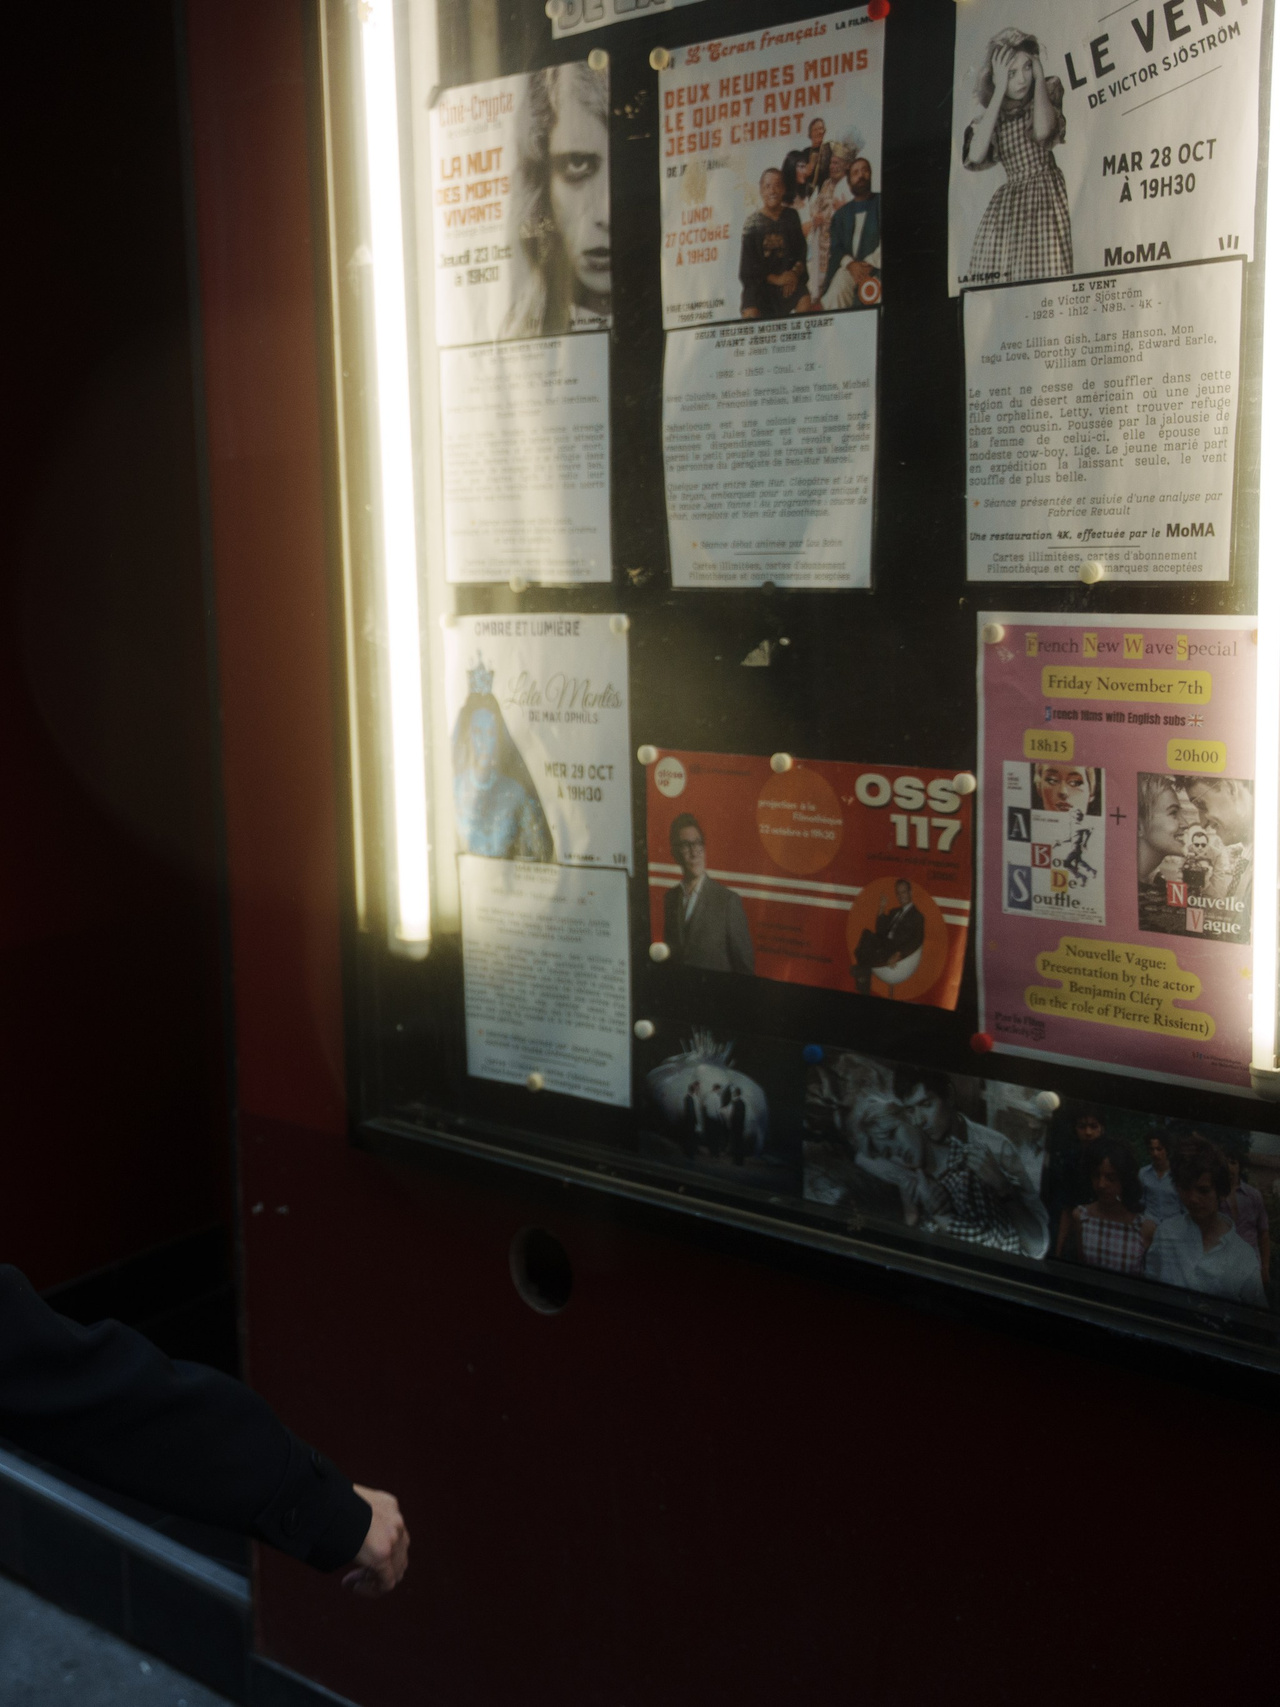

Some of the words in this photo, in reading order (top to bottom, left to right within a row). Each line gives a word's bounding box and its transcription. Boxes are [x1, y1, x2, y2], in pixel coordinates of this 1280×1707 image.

[760, 20, 827, 50] français
[1064, 34, 1115, 89] LE
[1131, 0, 1248, 53] VEN
[1087, 90, 1107, 109] DE
[1108, 63, 1159, 98] VICTOR
[1162, 21, 1241, 71] SJÖSTRÖM
[664, 83, 710, 110] DEUX
[719, 64, 794, 98] HEURES
[804, 49, 868, 82] MOINS
[664, 111, 684, 134] LE
[693, 97, 754, 128] QUART
[764, 81, 835, 115] AVANT
[730, 113, 805, 145] CHRIST
[440, 155, 462, 180] LA
[467, 146, 504, 175] NUIT
[1103, 151, 1143, 176] MAR
[1150, 146, 1171, 169] 28
[1178, 138, 1216, 164] OCT
[465, 175, 511, 200] MORTS
[1119, 175, 1132, 203] À
[1140, 172, 1196, 199] 19H30
[443, 201, 503, 229] VIVANTS
[681, 205, 714, 226] LUNDI
[1104, 241, 1172, 267] MoMA
[957, 275, 969, 284] LA
[1071, 282, 1086, 292] LE
[1089, 279, 1116, 290] VENT
[1040, 297, 1052, 308] de
[1058, 293, 1090, 306] Victor
[1095, 287, 1142, 303] Sjöström
[1033, 309, 1054, 319] 1928
[1026, 336, 1059, 348] Lillian
[1095, 331, 1116, 342] Lars
[1171, 324, 1194, 335] Mon
[1034, 346, 1076, 360] Dorothy
[1138, 337, 1180, 350] Edward
[1044, 357, 1086, 369] William
[1091, 353, 1142, 366] Orlamond
[989, 387, 1011, 396] vent
[1020, 386, 1032, 394] ne
[1041, 383, 1072, 393] cesse
[1082, 379, 1094, 390] de
[1103, 375, 1152, 388] souffler
[1162, 372, 1190, 384] dans
[1200, 370, 1231, 382] cette
[1009, 397, 1022, 407] du
[1030, 394, 1067, 406] désert
[1075, 389, 1133, 404] américain
[1166, 387, 1188, 397] une
[1196, 383, 1230, 397] jeune
[1098, 403, 1128, 414] vient
[1137, 400, 1183, 412] trouver
[1190, 397, 1230, 411] refuge
[1129, 529, 1147, 540] par
[1165, 522, 1215, 537] MoMA
[474, 620, 512, 636] OMBRE
[515, 620, 527, 636] ET
[1028, 637, 1079, 653] French
[1084, 637, 1119, 653] New
[1125, 638, 1174, 655] Wave
[1177, 639, 1237, 661] Special
[1048, 674, 1093, 695] Friday
[1097, 676, 1174, 693] November
[1178, 679, 1203, 695] 7th
[1106, 710, 1125, 723] with
[1127, 711, 1161, 726] English
[1163, 713, 1186, 727] subs
[1030, 738, 1068, 754] 18h15
[1175, 749, 1219, 763] 20h00
[544, 761, 567, 779] MER
[571, 764, 584, 779] 29
[587, 764, 614, 781] OCT
[855, 772, 961, 814] OSS
[889, 813, 962, 852] 117
[1009, 812, 1028, 839] A
[1053, 871, 1078, 890] De
[1169, 883, 1245, 913] Nouvelle
[1191, 910, 1241, 935] Vague
[1065, 944, 1121, 963] Nouvelle
[1125, 952, 1167, 971] Vague:
[1041, 959, 1119, 981] Presentation
[1122, 970, 1137, 987] by
[1140, 973, 1160, 988] the
[1162, 981, 1195, 993] actor
[1069, 981, 1126, 1000] Benjamin
[1130, 990, 1164, 1011] Cléry
[1029, 991, 1046, 1007] (in
[1049, 995, 1068, 1010] the
[1072, 1001, 1095, 1014] role
[1097, 1004, 1111, 1017] of
[1113, 1006, 1150, 1024] Pierre
[1154, 1013, 1210, 1037] Rissient)
